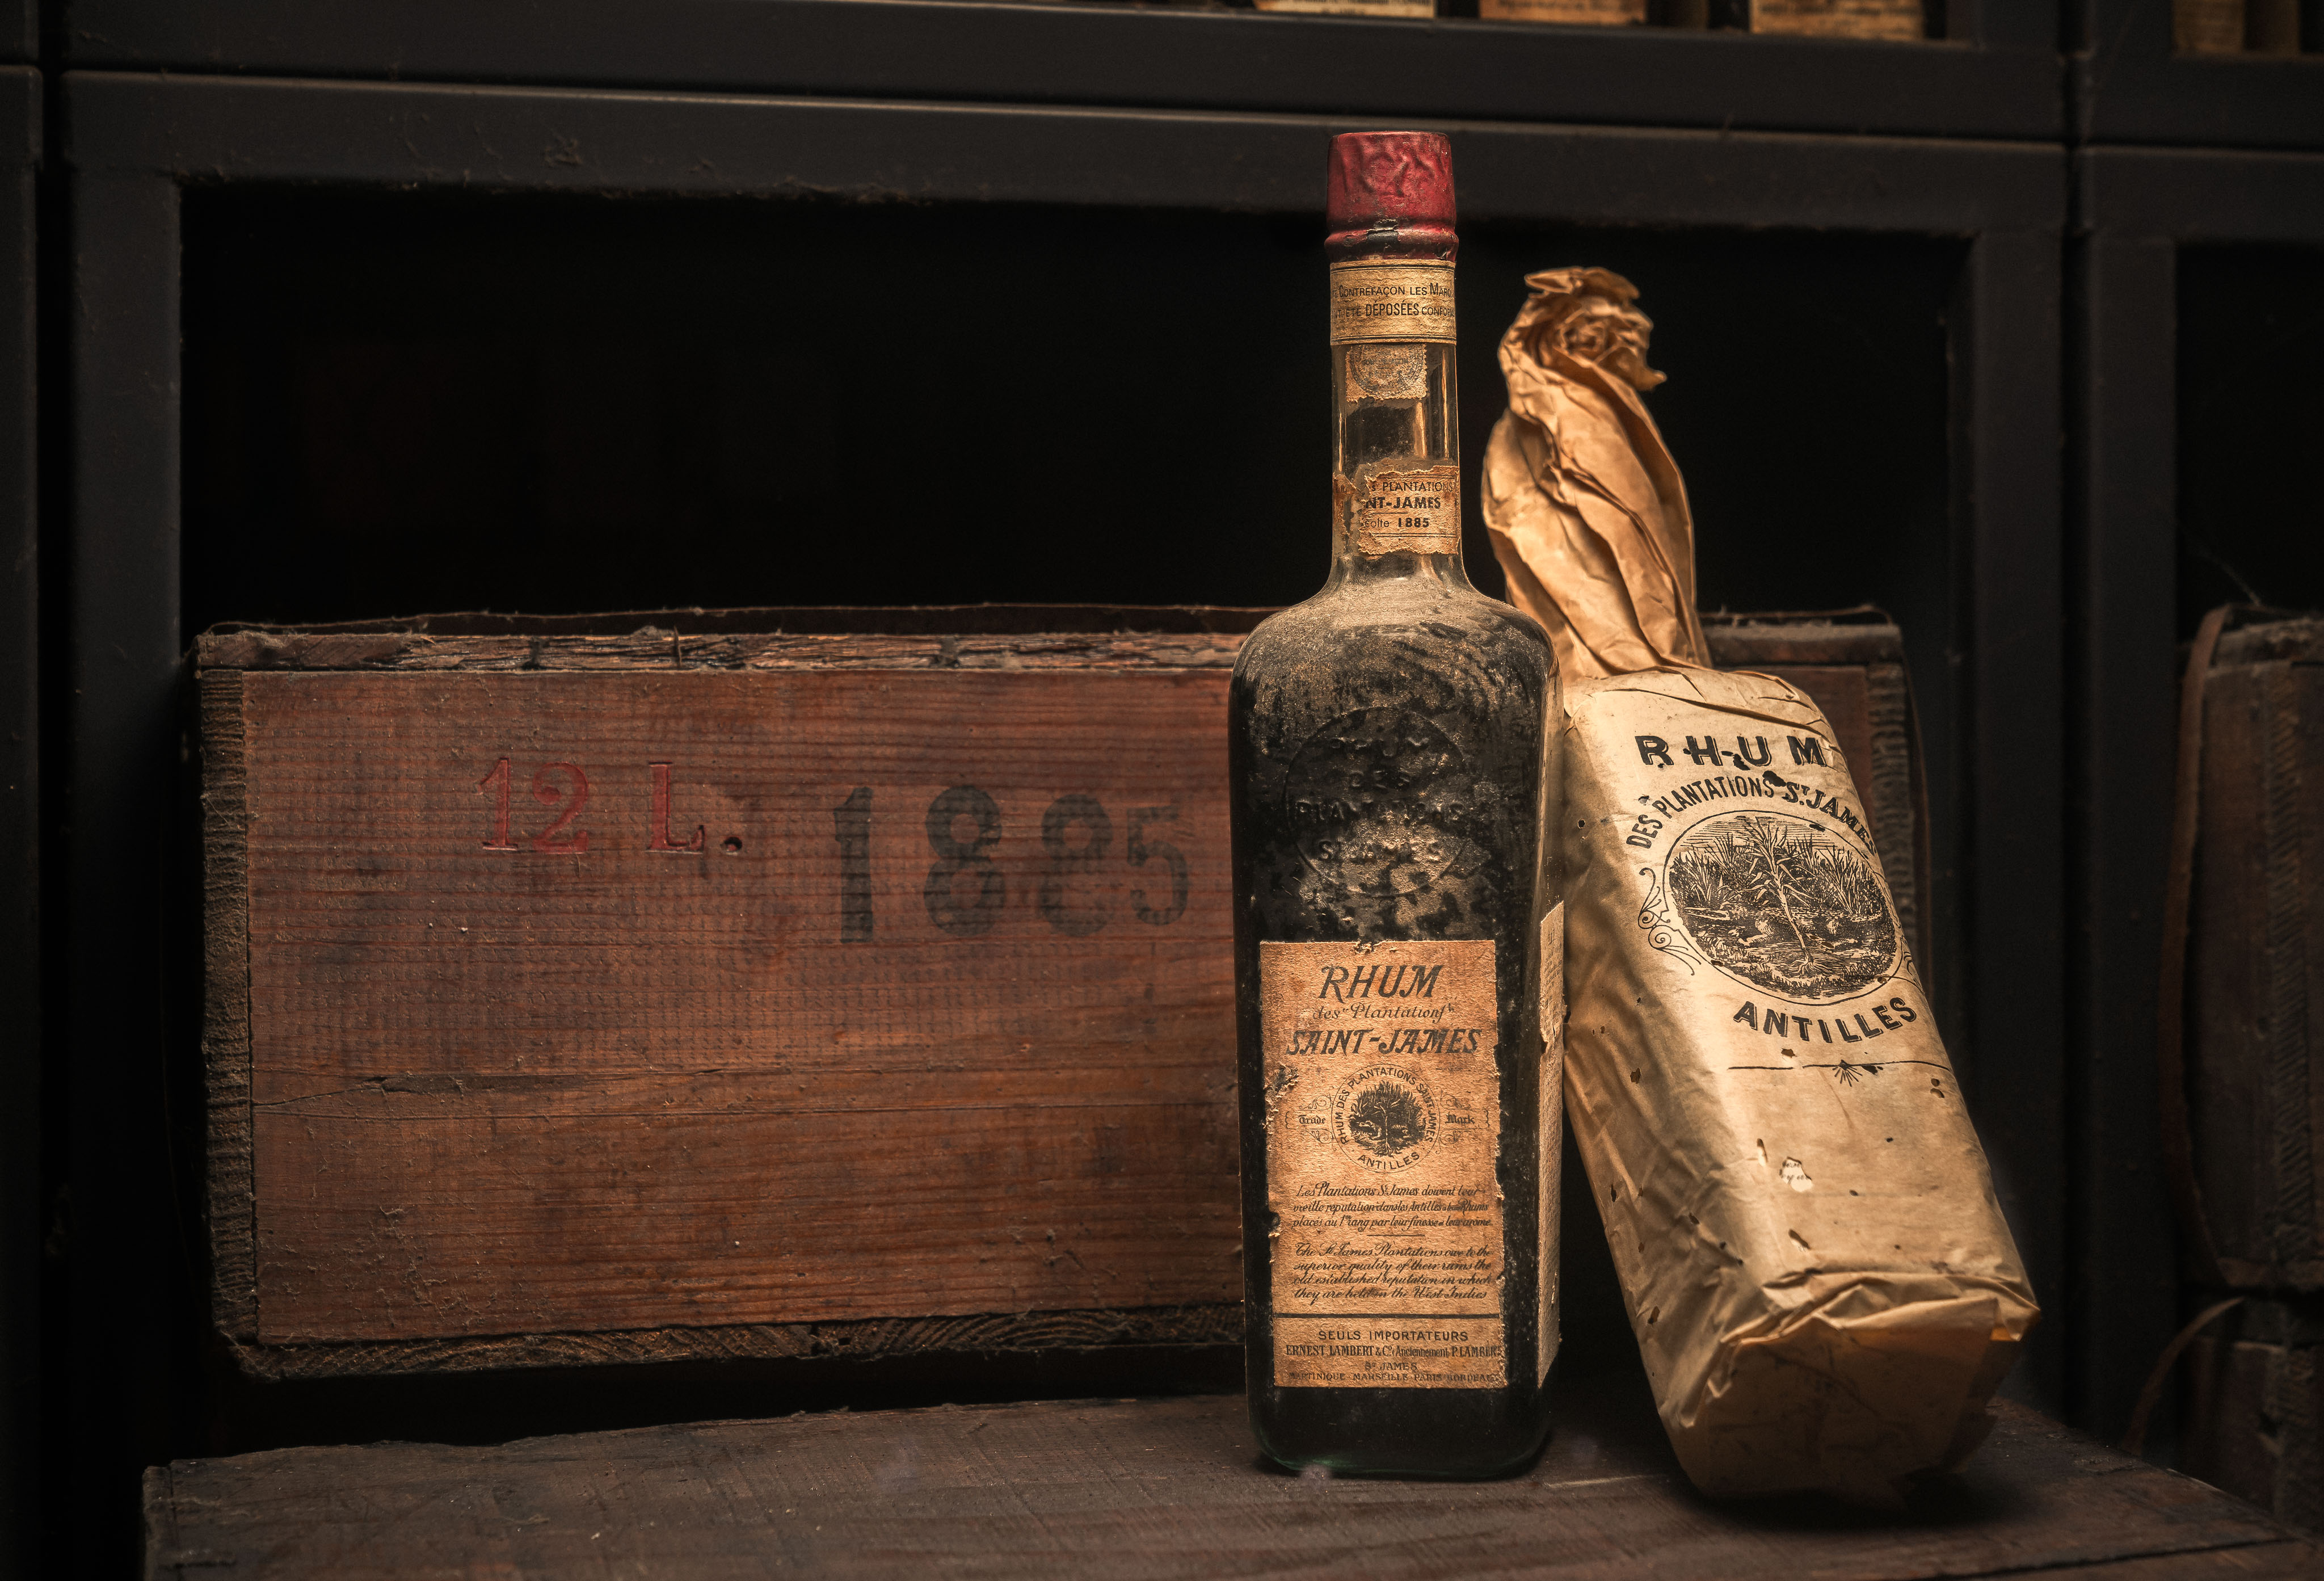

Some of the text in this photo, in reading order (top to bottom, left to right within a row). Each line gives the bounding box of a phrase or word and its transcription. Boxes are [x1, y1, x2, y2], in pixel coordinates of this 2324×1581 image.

[1409, 286, 1428, 296] LES
[1366, 300, 1420, 317] DÉPOSÉES
[1382, 481, 1453, 493] PLANTATIONS
[1398, 518, 1430, 528] 1885
[1635, 735, 1828, 767] RHUM
[479, 756, 590, 855] 12
[1626, 814, 1664, 850] DES
[1652, 775, 1775, 819] PLANTATIONS
[833, 785, 1189, 943] 1885
[1319, 964, 1443, 1004] RHUM
[1312, 1006, 1340, 1020] des
[1733, 997, 1917, 1044] ANTILLES
[1286, 1028, 1483, 1057] SAINT-JAMES
[1348, 1067, 1416, 1090] PLANTATIONS
[1336, 1089, 1350, 1109] DES
[1298, 1112, 1475, 1125] Trade Mark
[1425, 1109, 1437, 1143] JAMES
[1336, 1112, 1350, 1145] RHUM
[1358, 1151, 1420, 1170] ANTILLES
[1295, 1185, 1315, 1197] Les
[1315, 1181, 1376, 1197] Plantations
[1388, 1184, 1420, 1196] James
[1293, 1200, 1324, 1212] vieille
[1408, 1200, 1442, 1212] Antilles
[1369, 1220, 1390, 1230] par
[1295, 1242, 1317, 1257] The
[1374, 1241, 1443, 1257] Plantations
[1293, 1262, 1346, 1275] superior
[1348, 1258, 1393, 1276] quality
[1396, 1258, 1413, 1274] of
[1315, 1272, 1383, 1285] established
[1381, 1273, 1439, 1288] reputation
[1294, 1287, 1321, 1306] they
[1323, 1290, 1345, 1299] are
[1318, 1330, 1469, 1342] SEULS IMPORTATEURS
[1286, 1344, 1325, 1356] ERNEST
[1329, 1344, 1375, 1357] LAMBERT
[1375, 1347, 1382, 1356] &
[1380, 1361, 1418, 1372] JAMES
[1288, 1372, 1346, 1381] MARTINIQUE
[1353, 1372, 1408, 1382] MARSEILLE
